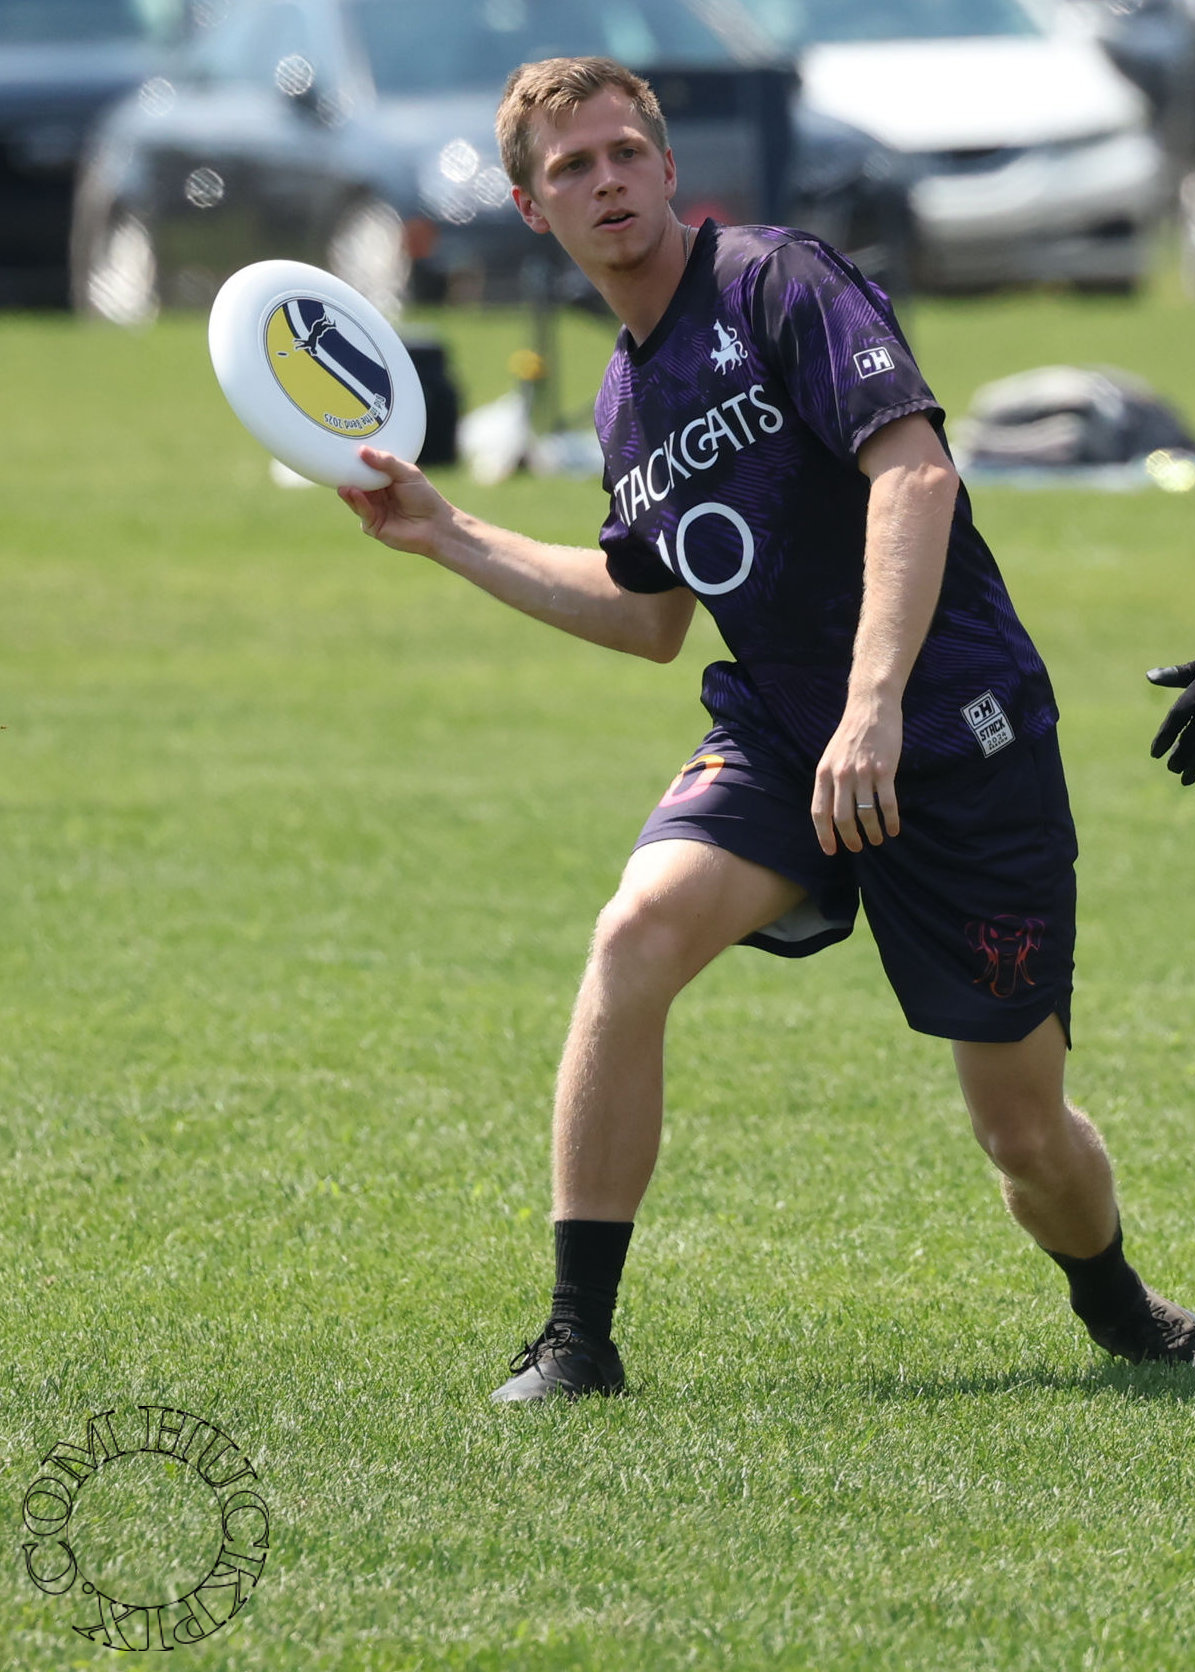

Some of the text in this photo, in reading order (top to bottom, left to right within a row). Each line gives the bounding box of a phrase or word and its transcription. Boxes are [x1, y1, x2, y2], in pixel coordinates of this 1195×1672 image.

[324, 413, 344, 429] 2025
[360, 413, 374, 425] the
[613, 384, 783, 527] TACKCATS
[979, 716, 1006, 742] STACK
